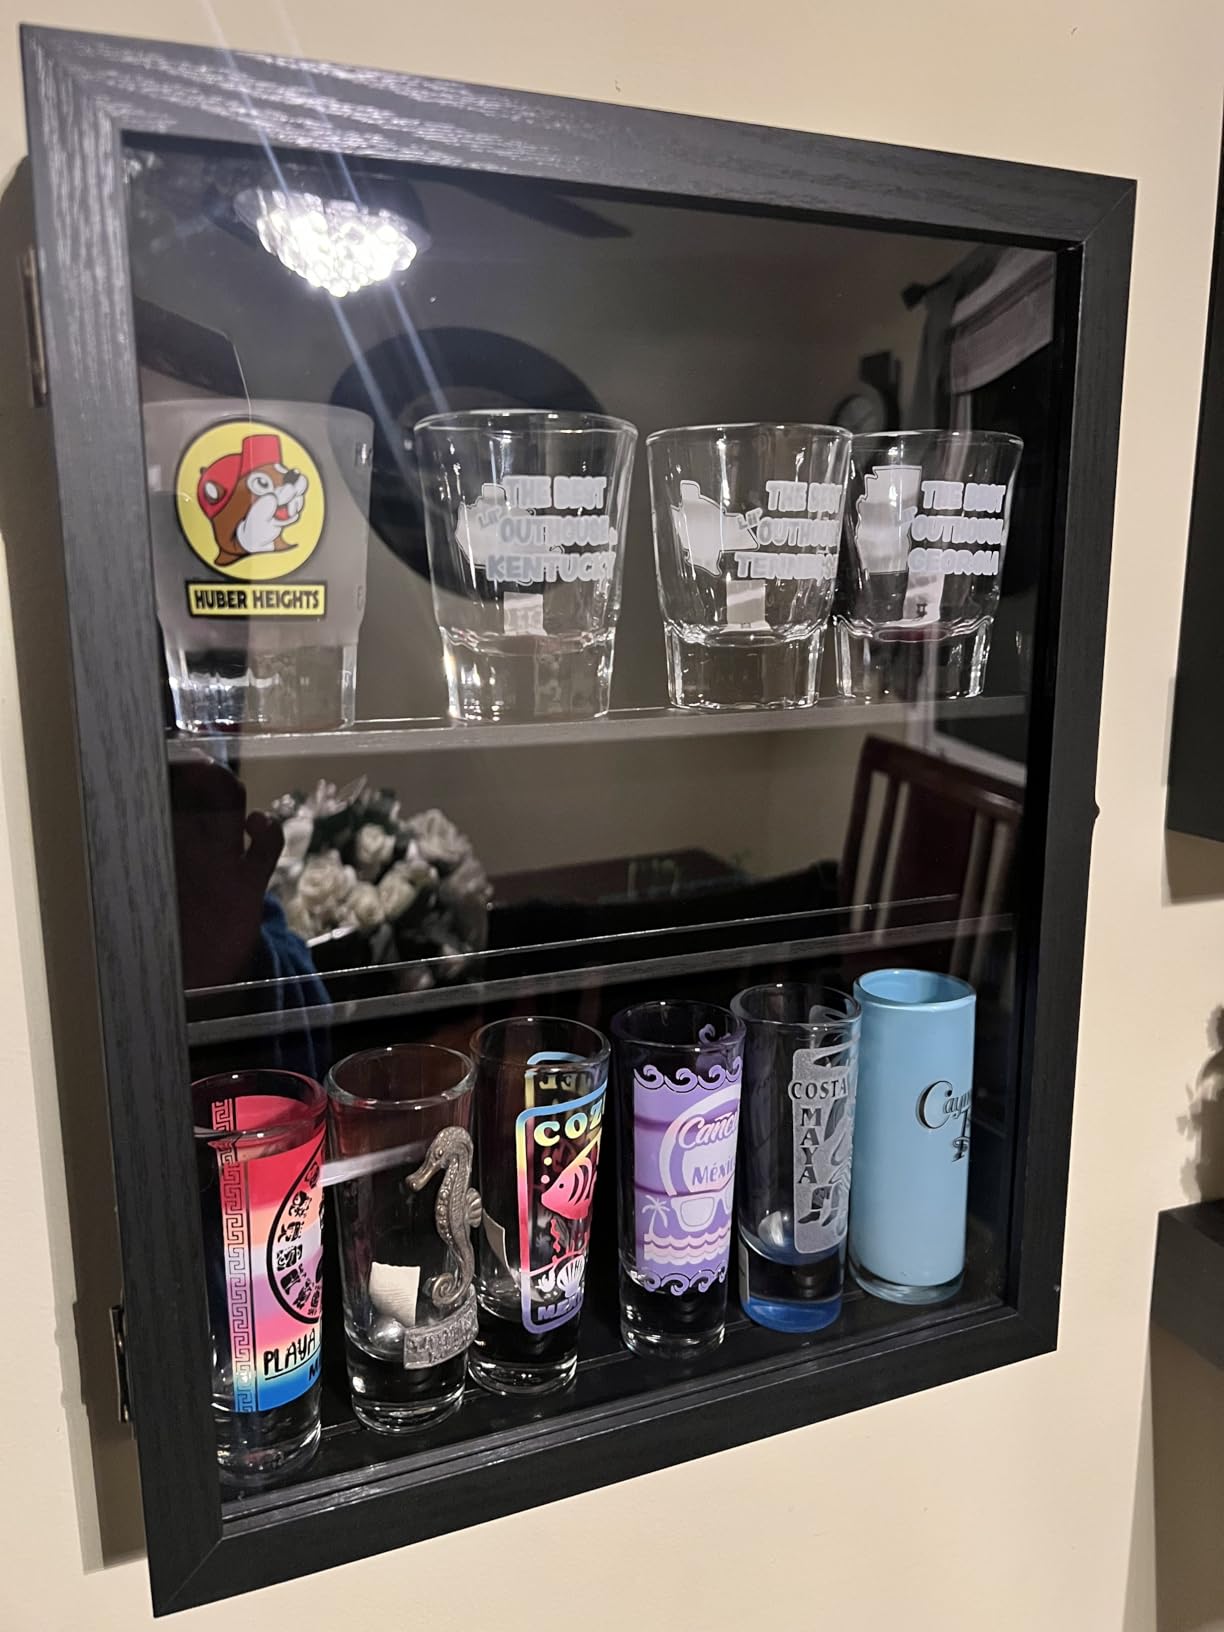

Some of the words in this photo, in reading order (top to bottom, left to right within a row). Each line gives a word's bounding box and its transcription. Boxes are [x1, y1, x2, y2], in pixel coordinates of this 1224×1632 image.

[502, 475, 551, 509] THE
[553, 475, 608, 509] BEST
[766, 480, 808, 511] THE
[921, 481, 964, 510] THE
[486, 551, 617, 582] KENTUCKY
[194, 589, 248, 609] HUBER
[252, 589, 320, 609] HEIGHTS
[791, 1078, 846, 1100] COSTA
[798, 1107, 822, 1184] MAYA
[264, 1327, 316, 1376] PLAYA
